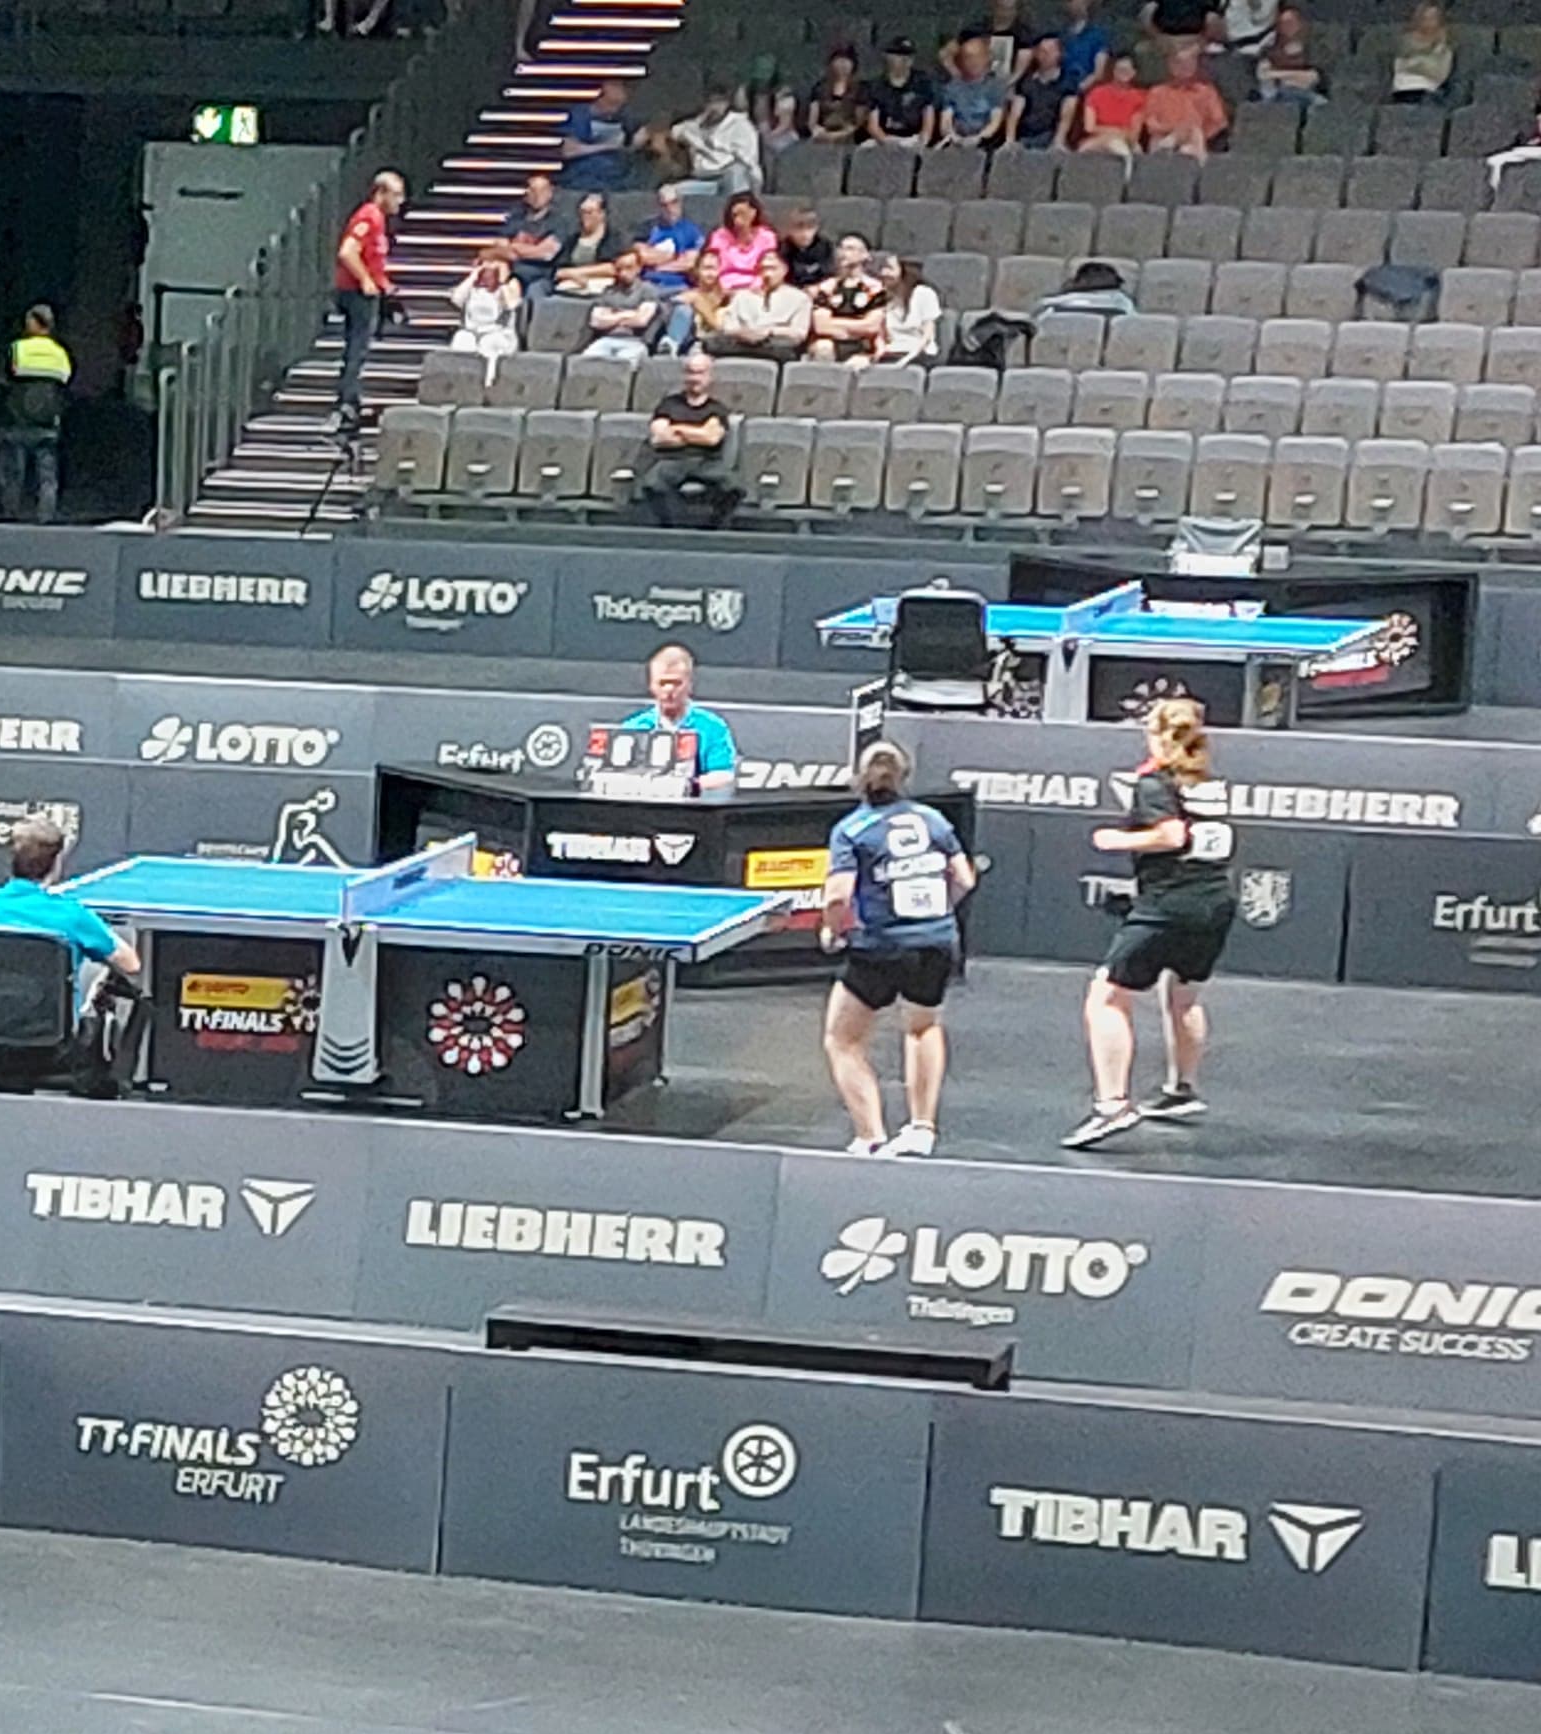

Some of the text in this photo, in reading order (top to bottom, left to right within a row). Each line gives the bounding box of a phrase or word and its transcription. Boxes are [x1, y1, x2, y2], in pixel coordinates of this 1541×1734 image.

[139, 571, 307, 605] LIEBHERR
[406, 577, 519, 614] LOTTO
[196, 722, 327, 766] LOTTO
[951, 769, 1100, 807] TIBHAR
[1229, 784, 1460, 828] LIEBHERR
[1433, 895, 1540, 932] Erfurt
[27, 1172, 226, 1229] TIBHAR
[405, 1199, 726, 1267] LIEBHERR
[910, 1225, 1130, 1299] LOTTO
[1288, 1321, 1534, 1362] CREATE SUCCESS
[175, 1467, 285, 1503] ERFURT
[567, 1452, 720, 1511] Erfurt
[990, 1486, 1249, 1562] TIBHAR
